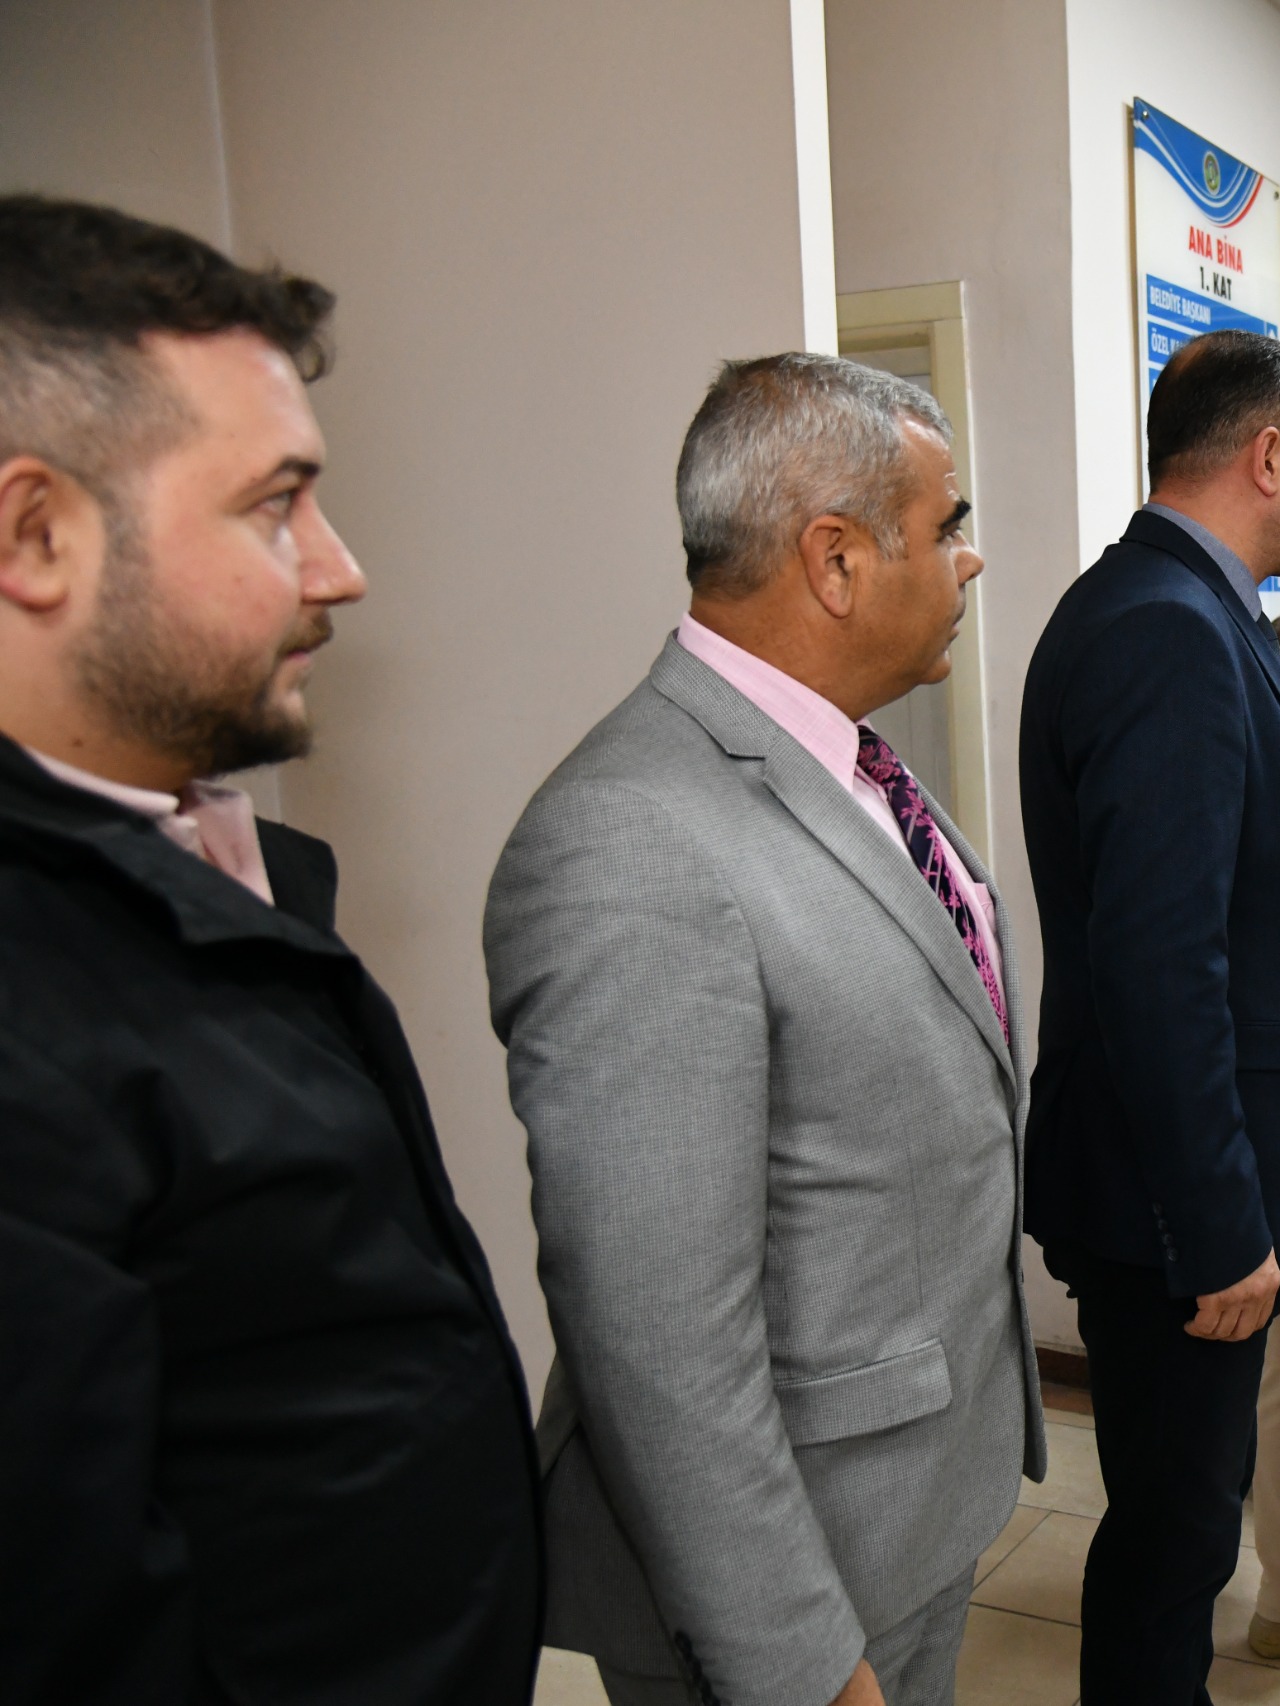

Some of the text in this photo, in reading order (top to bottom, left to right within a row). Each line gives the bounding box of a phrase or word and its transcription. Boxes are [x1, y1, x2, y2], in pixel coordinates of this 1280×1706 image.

[1189, 225, 1243, 274] ANA BİNA
[1200, 266, 1232, 301] 1. KAT
[1150, 286, 1211, 325] BELEDİYE BAŞKANI
[1151, 328, 1170, 355] ÖZEL
